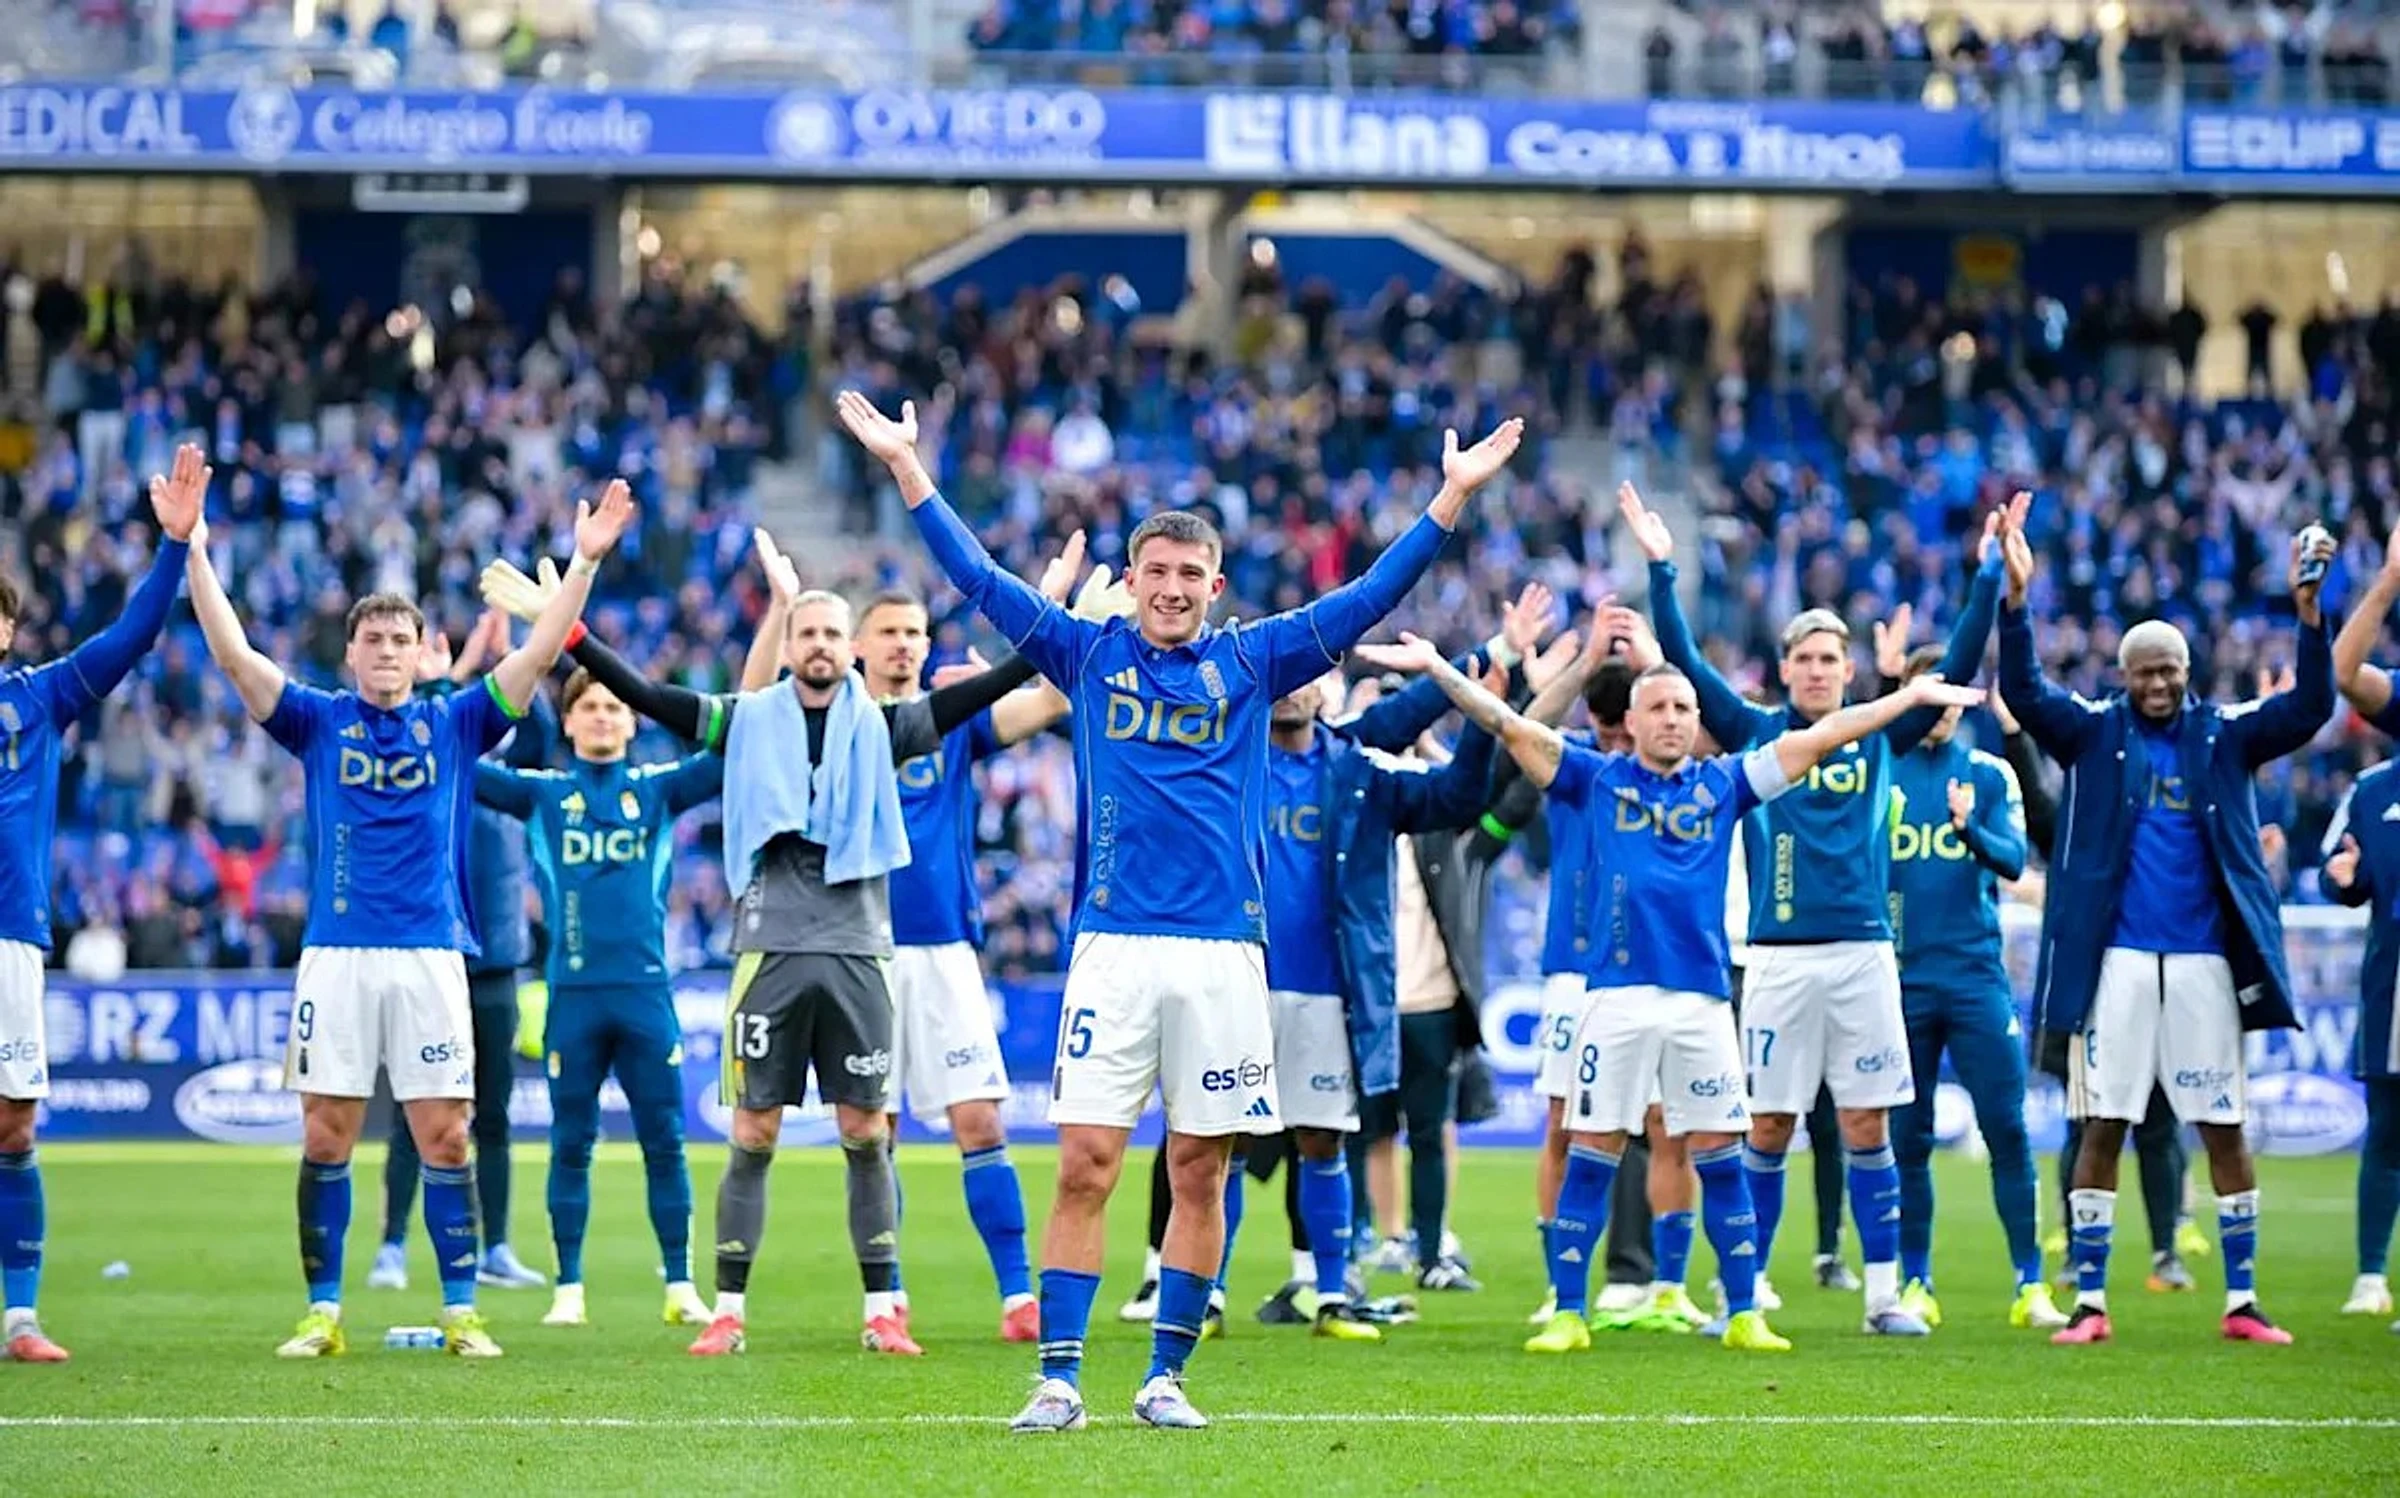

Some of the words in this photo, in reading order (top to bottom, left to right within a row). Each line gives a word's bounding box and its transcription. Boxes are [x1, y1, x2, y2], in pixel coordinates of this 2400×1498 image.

[1105, 692, 1228, 745] DIGI
[339, 746, 437, 792] DIGI
[1795, 757, 1867, 794] IGI
[1614, 798, 1713, 841] DIGI
[562, 826, 648, 866] DIGI
[1891, 822, 1975, 862] DIG
[88, 988, 181, 1064] RZ
[299, 1000, 315, 1043] 9
[734, 1012, 771, 1059] 13
[1060, 1005, 1095, 1059] 15
[1579, 1044, 1599, 1084] 8
[1747, 1026, 1776, 1067] 17
[1202, 1048, 1274, 1092] esfer
